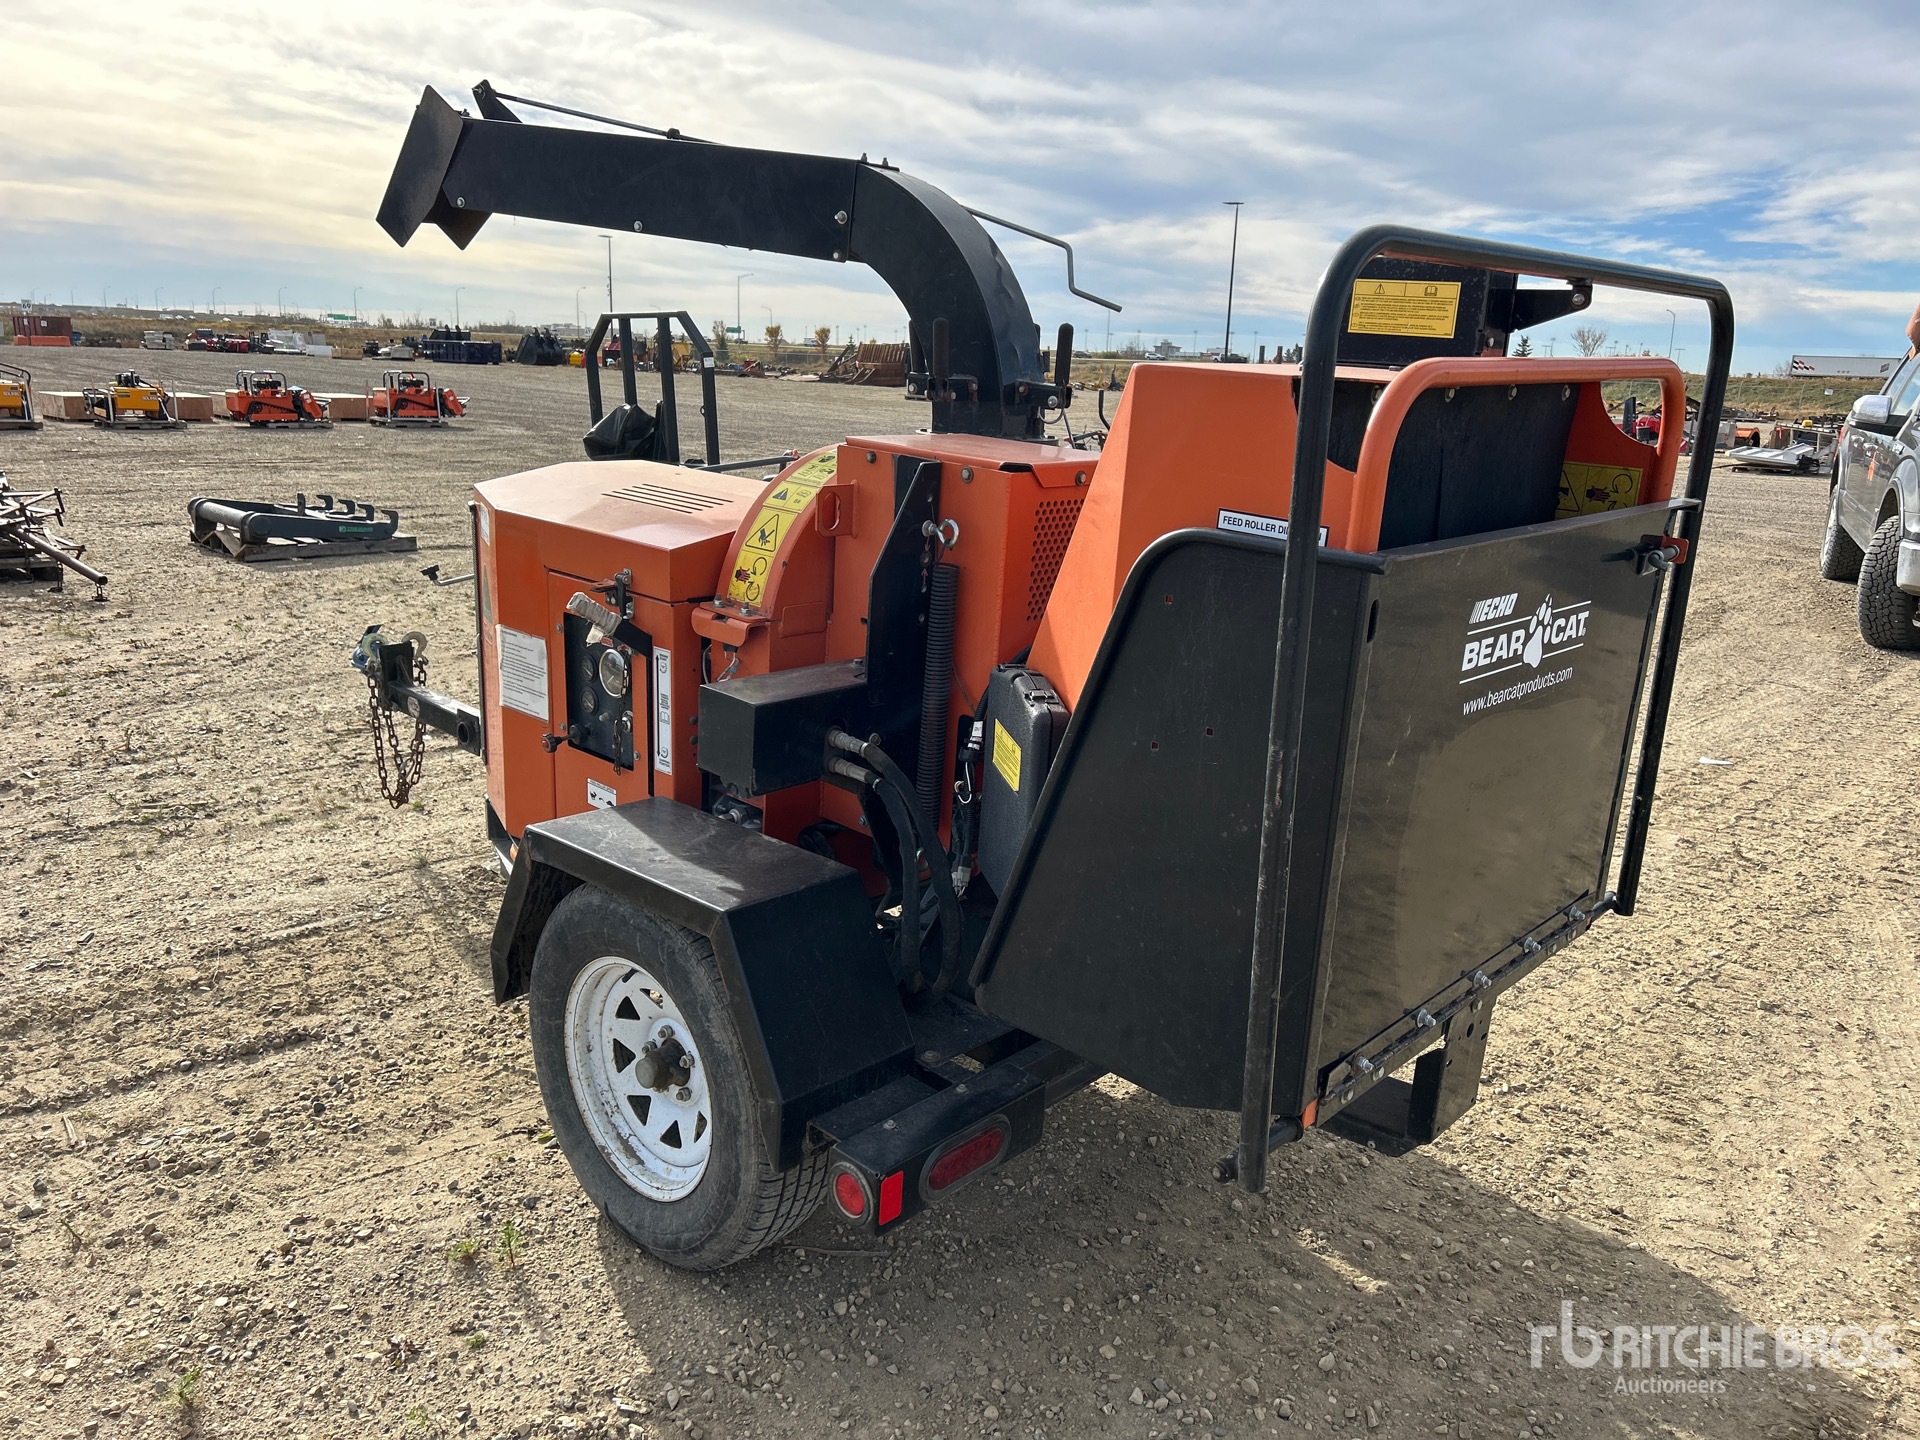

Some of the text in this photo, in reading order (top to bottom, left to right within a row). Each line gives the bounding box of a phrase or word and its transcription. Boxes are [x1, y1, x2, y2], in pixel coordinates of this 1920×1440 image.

[1222, 515, 1243, 527] FEED
[1244, 520, 1277, 533] ROLLER
[1479, 593, 1518, 622] ECHO
[1461, 611, 1589, 671] BEAR CAT
[1463, 667, 1573, 715] www.bearcatproducts.com
